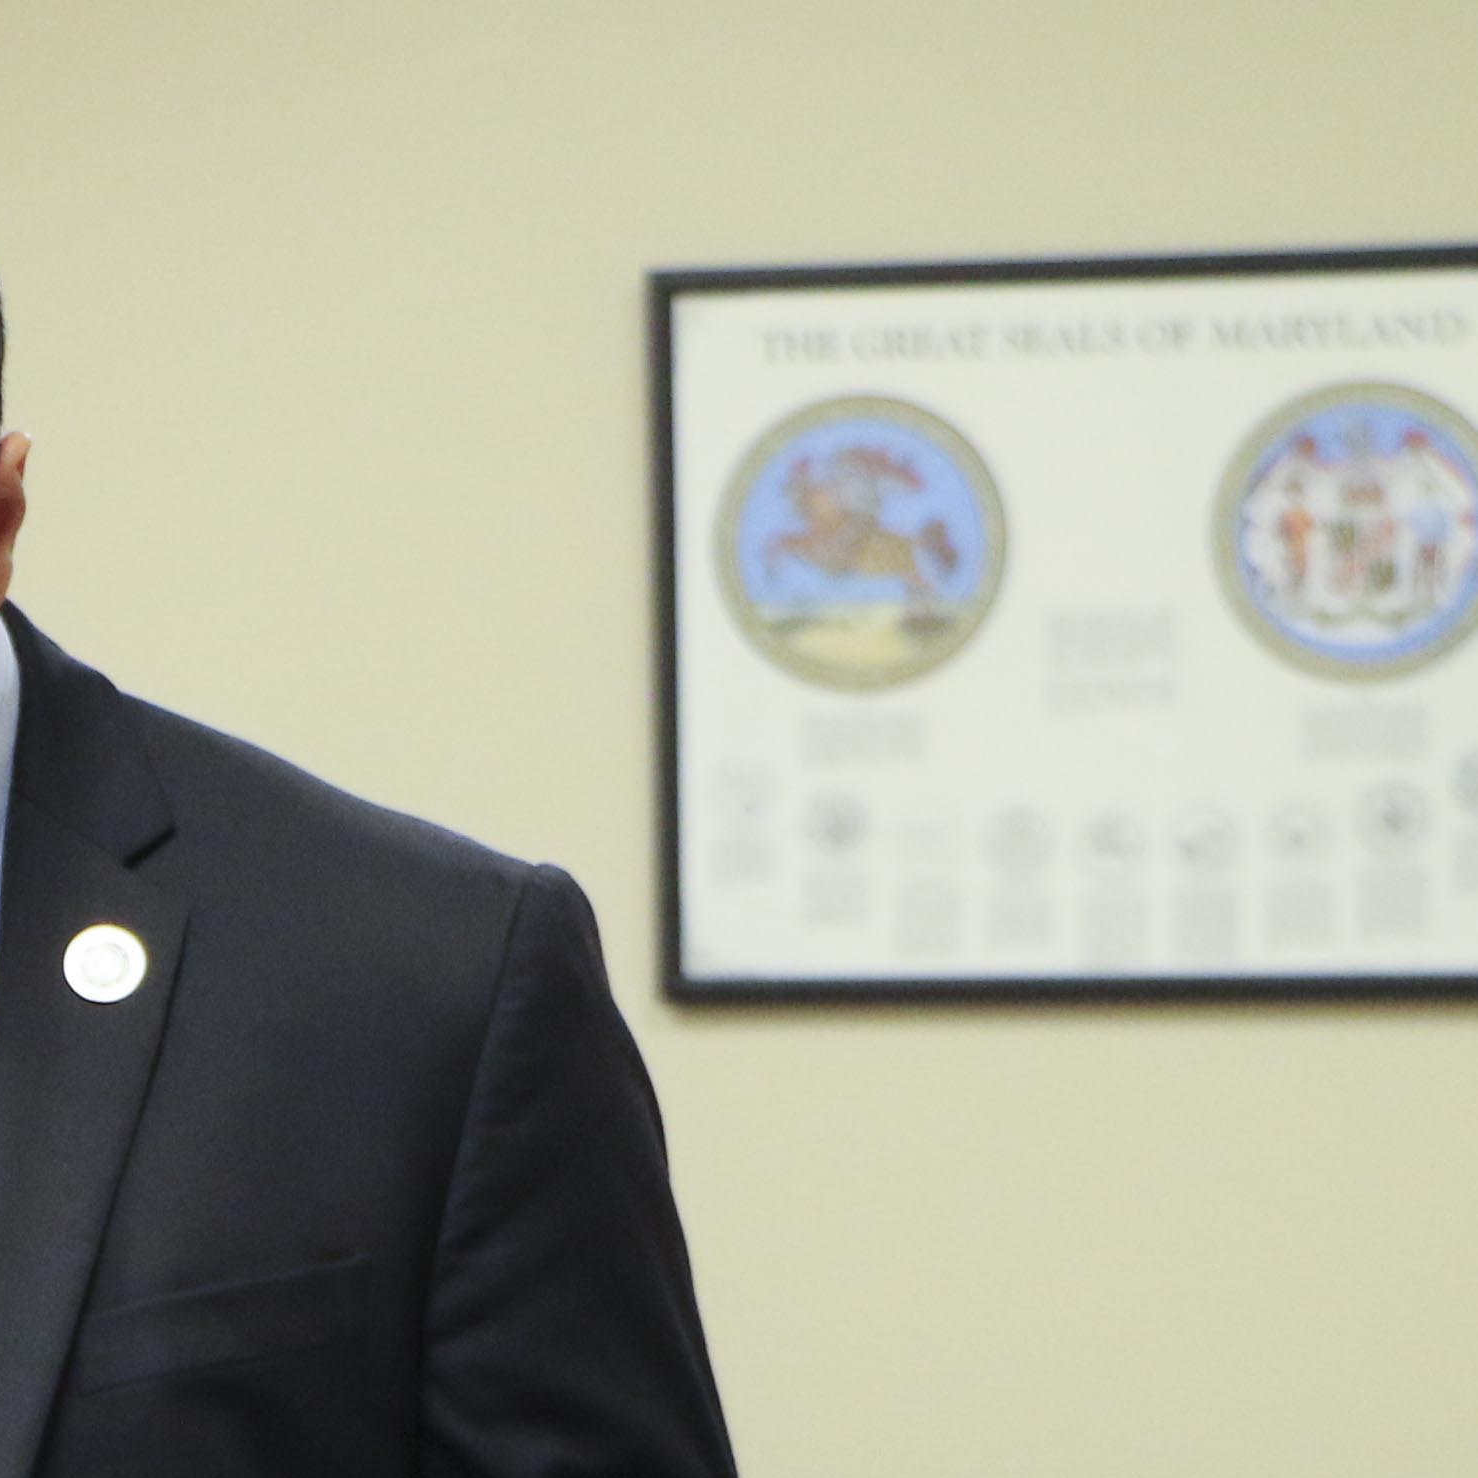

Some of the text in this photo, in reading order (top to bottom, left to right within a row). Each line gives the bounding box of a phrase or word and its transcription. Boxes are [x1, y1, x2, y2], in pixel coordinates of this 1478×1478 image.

[760, 328, 838, 365] THE
[848, 324, 991, 362] GREAT
[1136, 316, 1195, 354] OF
[1208, 307, 1469, 353] MARYLAND
